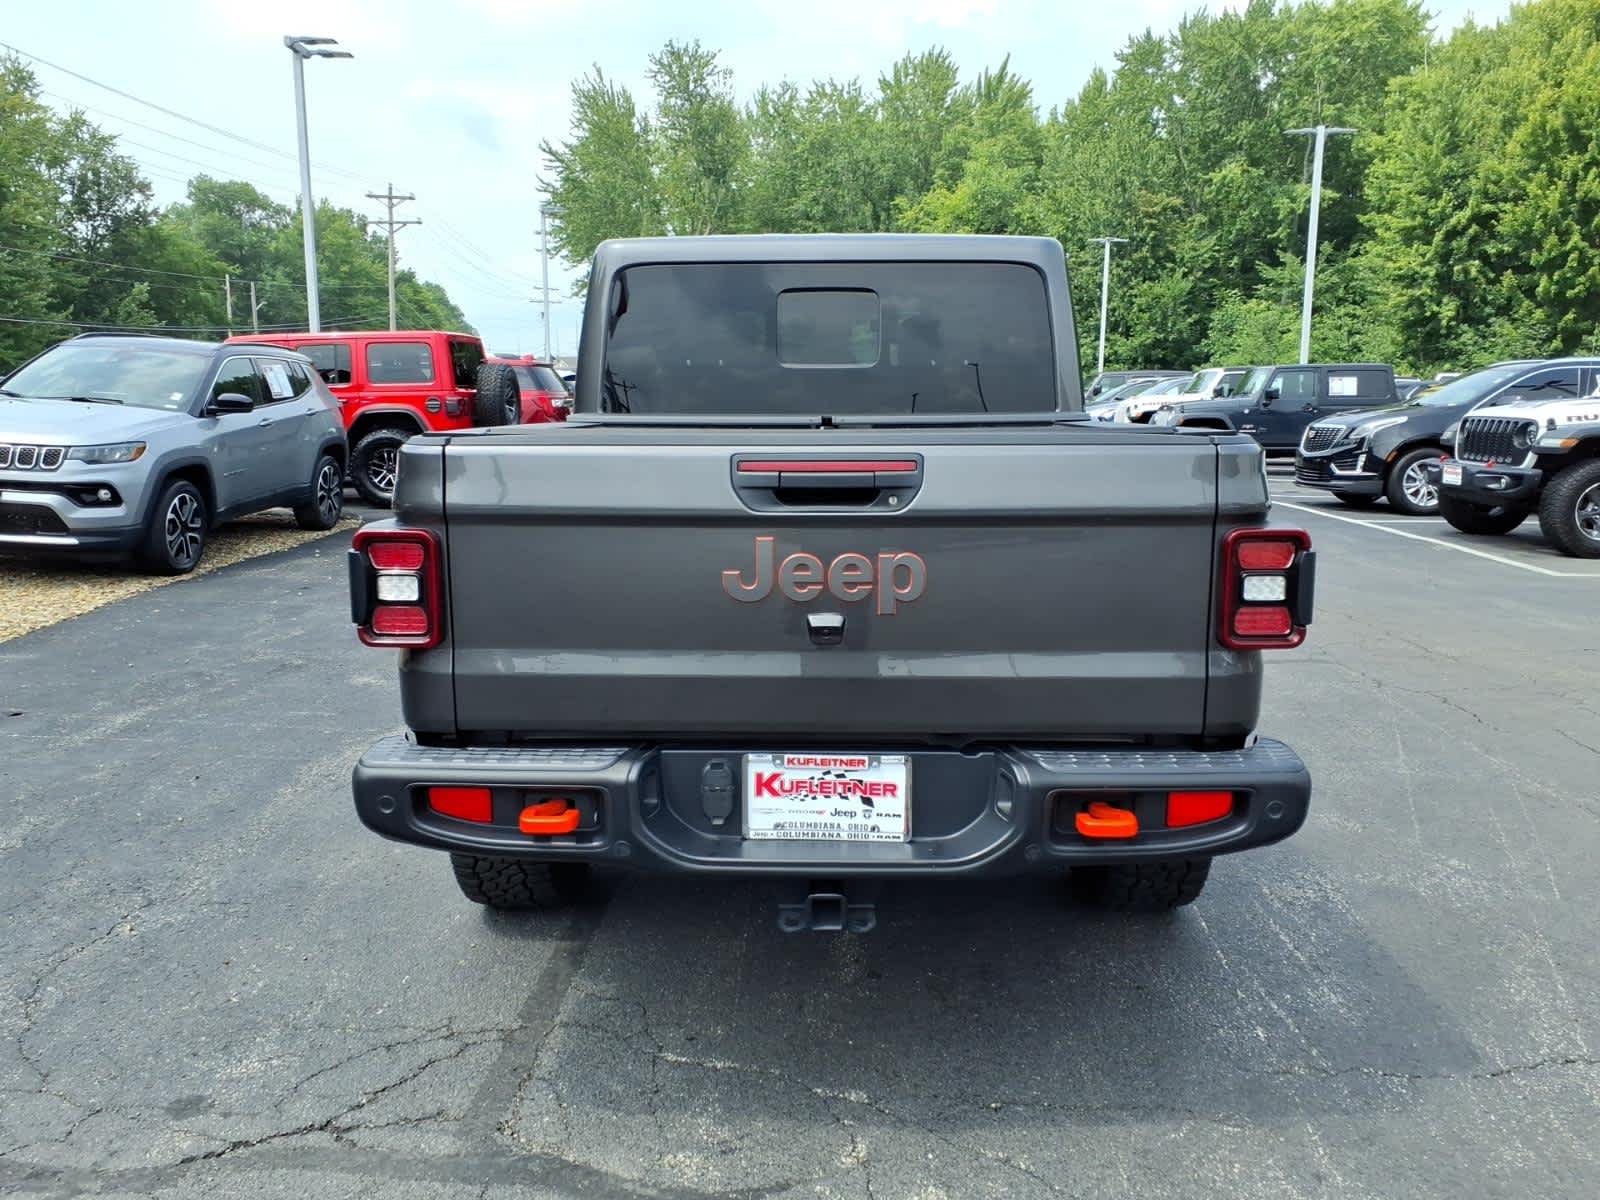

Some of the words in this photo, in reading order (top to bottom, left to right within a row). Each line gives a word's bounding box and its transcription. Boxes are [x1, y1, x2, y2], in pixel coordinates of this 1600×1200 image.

[721, 536, 927, 616] Jeep
[786, 757, 867, 768] KUFLEITNER
[755, 772, 898, 798] KUFLEITNER
[830, 807, 857, 819] Jeep
[847, 823, 869, 832] OHIO
[847, 832, 870, 840] OHIO
